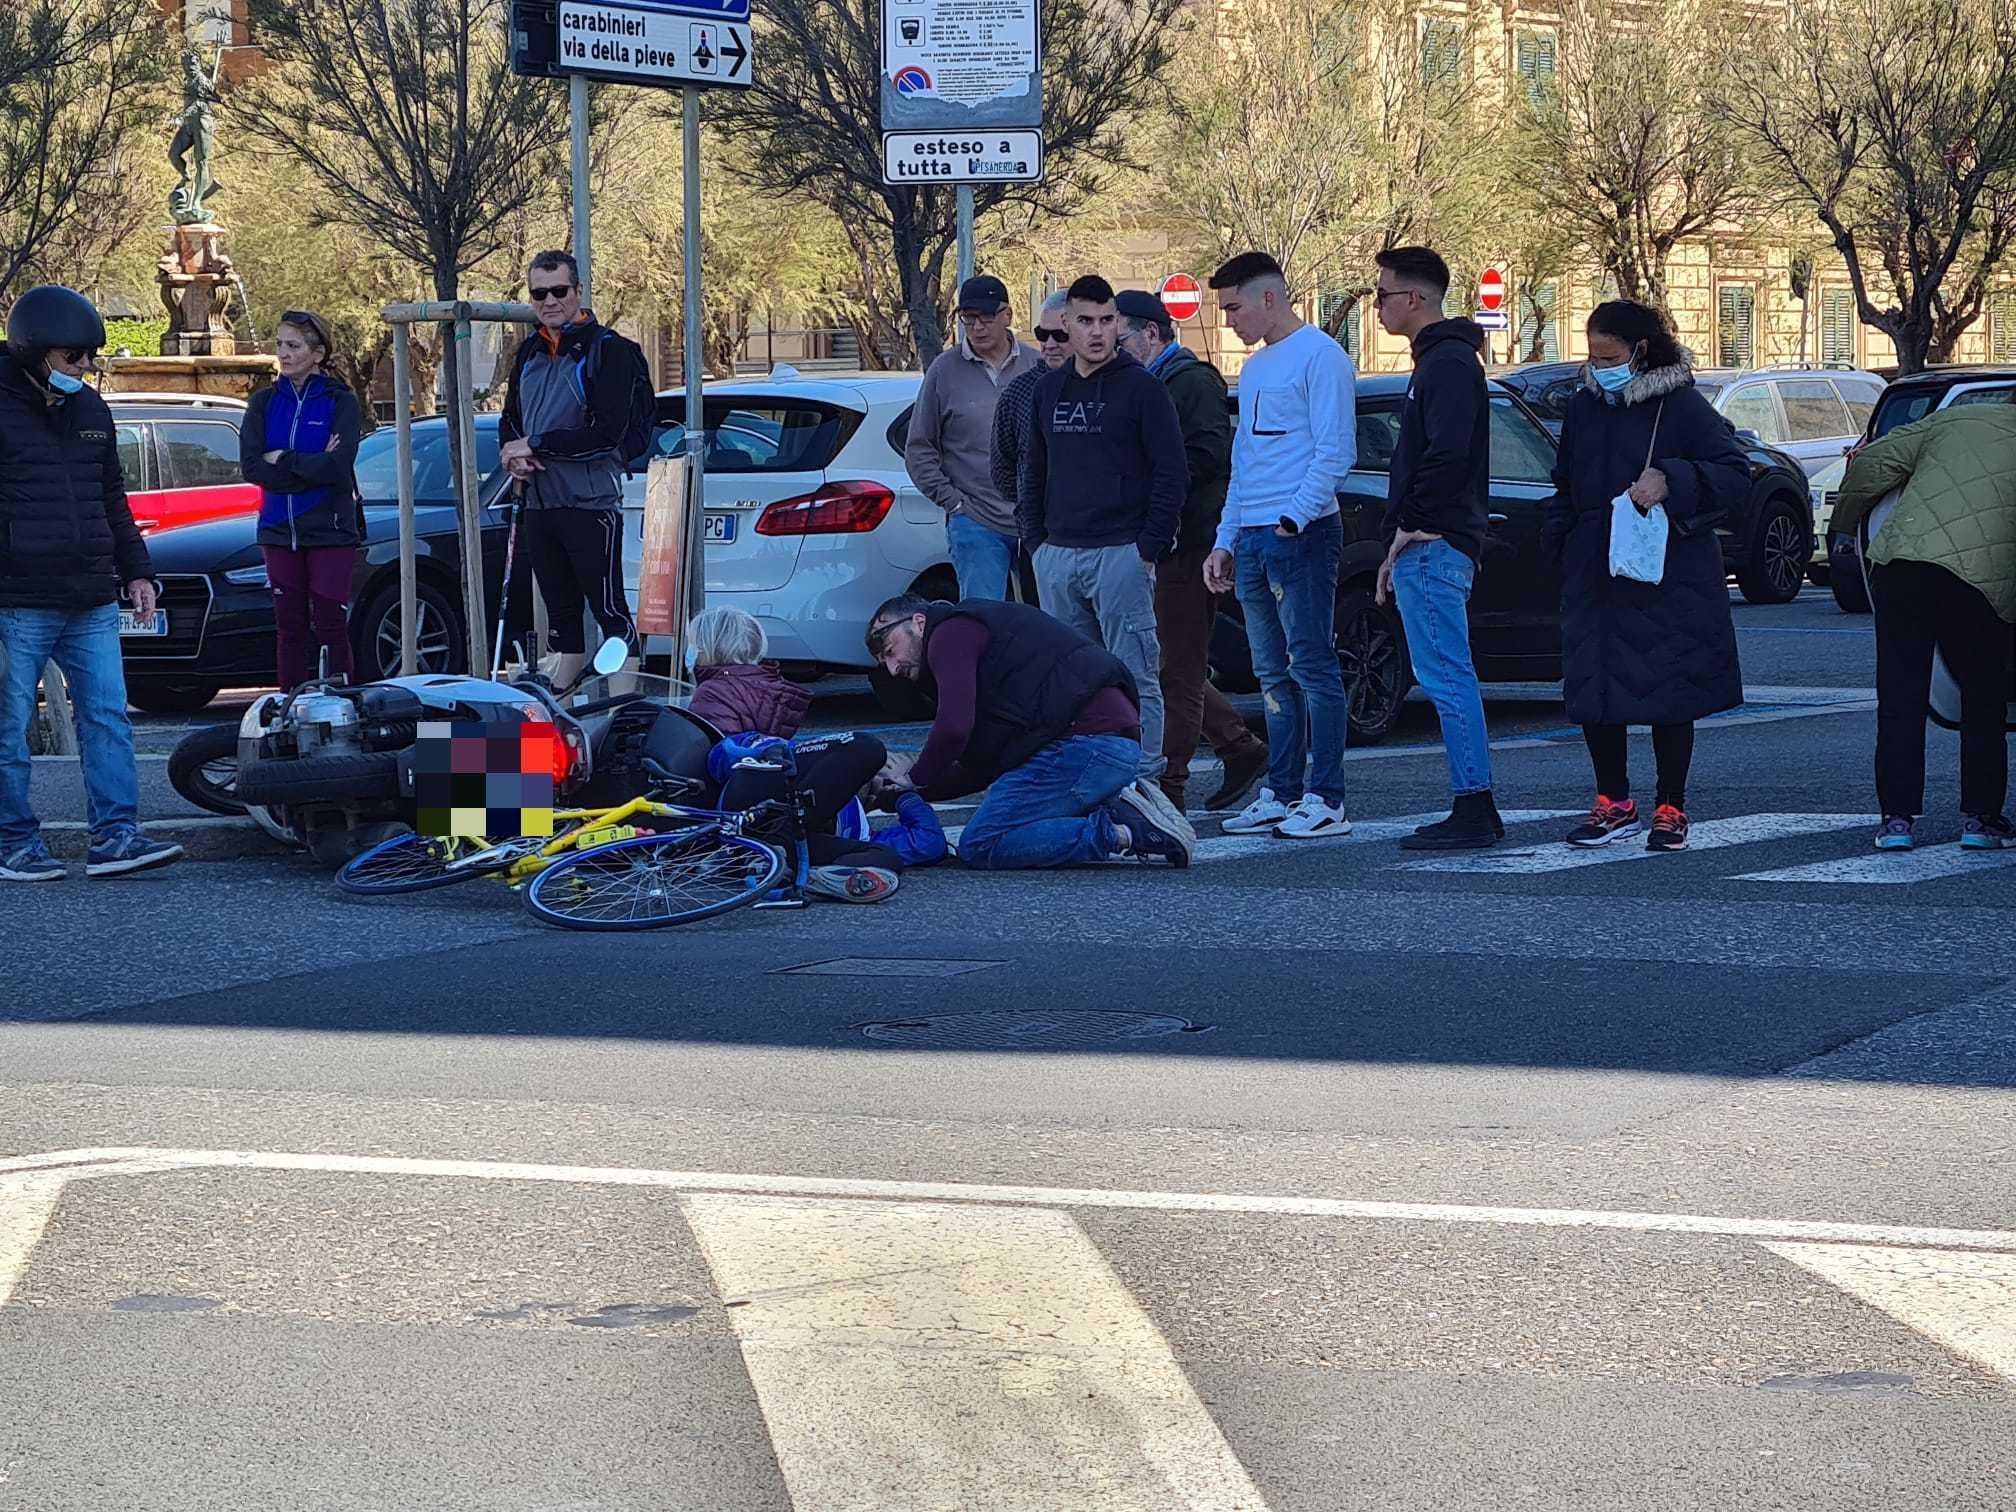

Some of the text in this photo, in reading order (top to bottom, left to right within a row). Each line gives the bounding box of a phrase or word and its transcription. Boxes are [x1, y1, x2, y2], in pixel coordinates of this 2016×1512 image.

[563, 11, 646, 37] carabinieri
[563, 36, 675, 68] via della pieve
[913, 138, 1011, 155] esteso a
[897, 159, 952, 176] tutta
[1053, 401, 1105, 424] EA7
